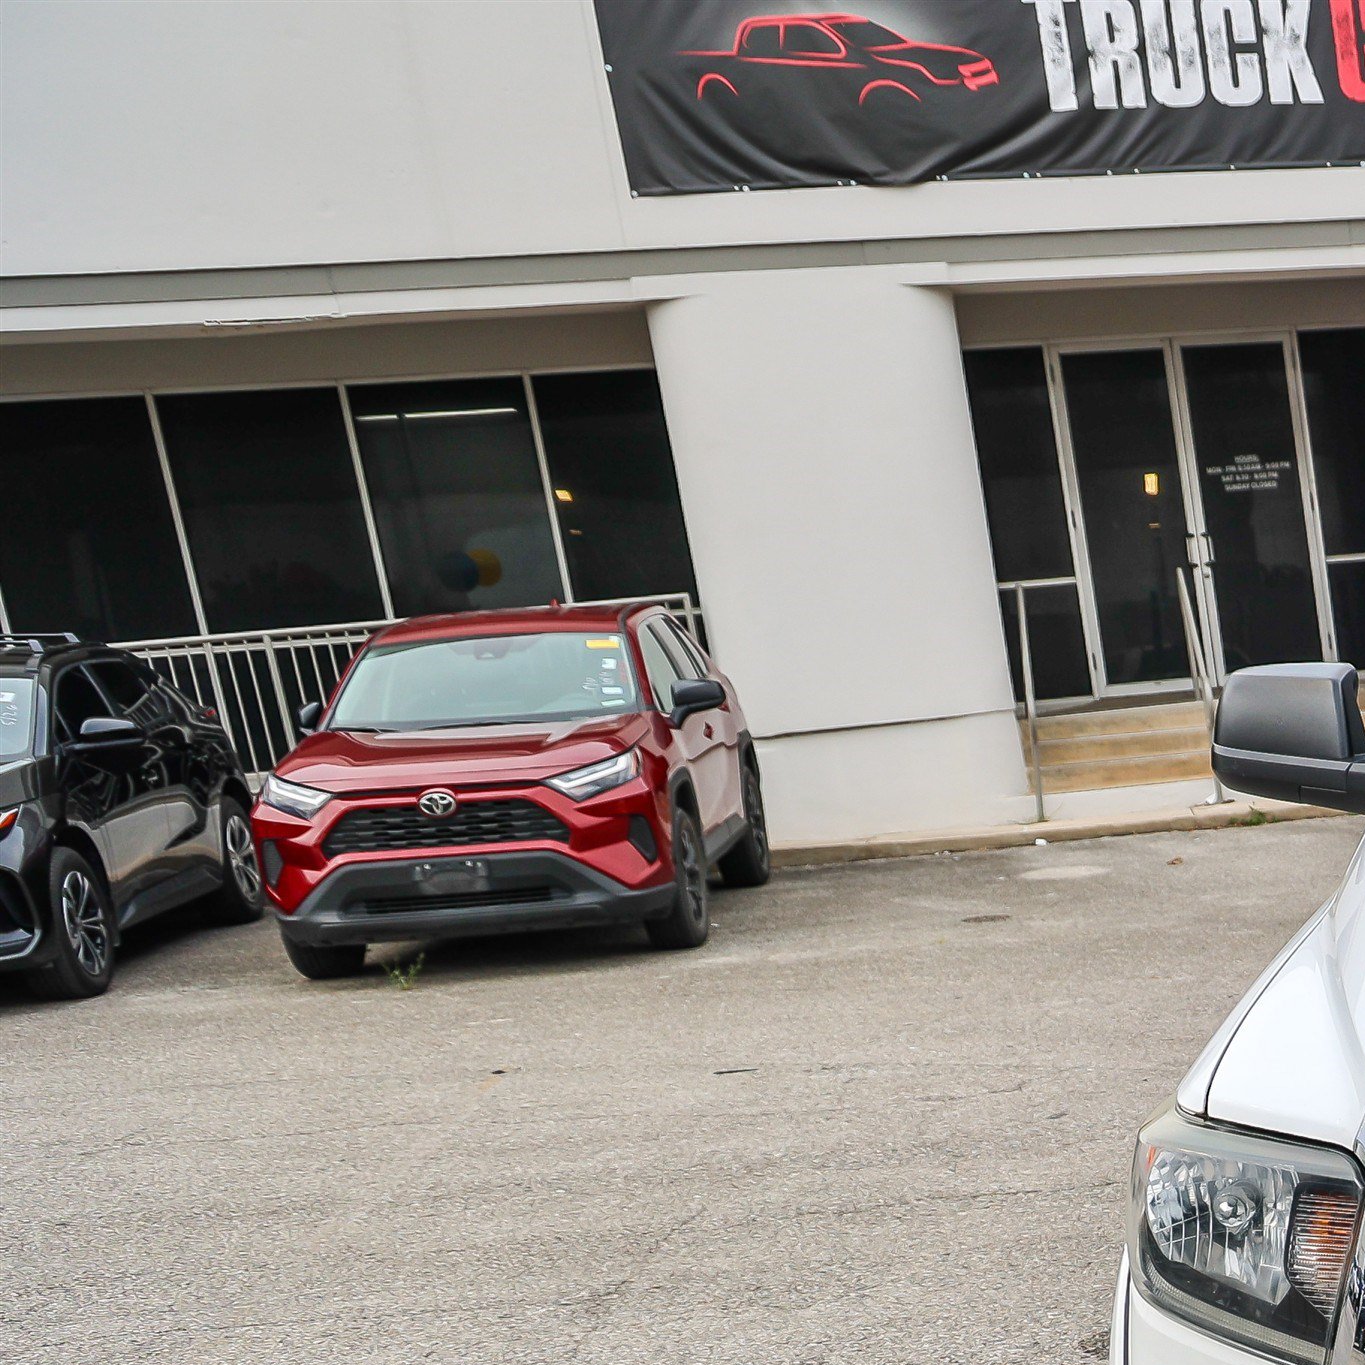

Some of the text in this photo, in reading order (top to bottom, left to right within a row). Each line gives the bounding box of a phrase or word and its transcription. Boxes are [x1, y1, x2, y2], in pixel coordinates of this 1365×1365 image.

[1020, 0, 1324, 112] TRUCK
[1225, 480, 1277, 491] SUNDAY CLOSED
